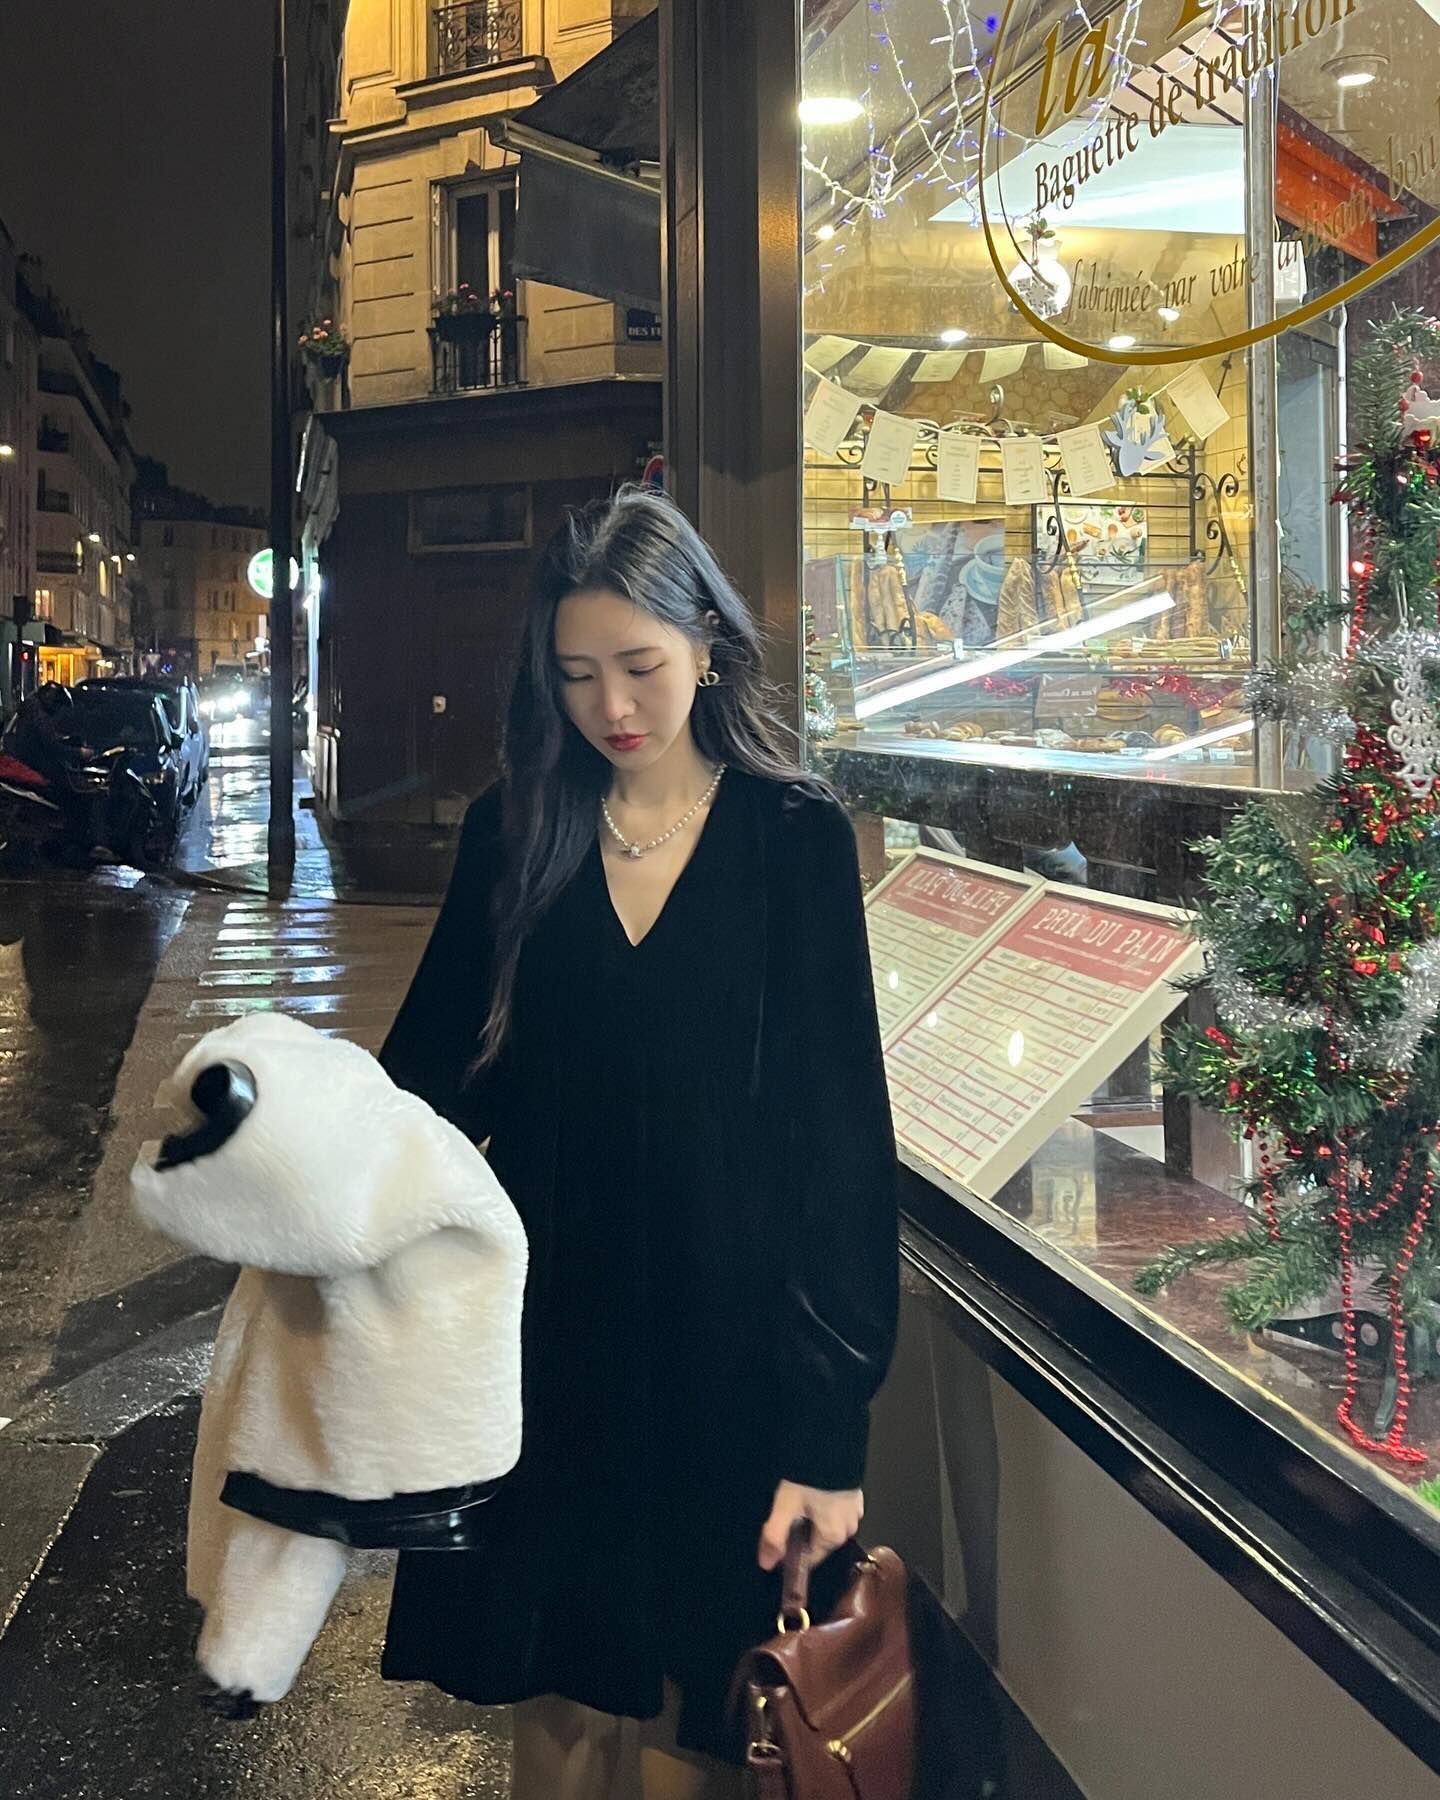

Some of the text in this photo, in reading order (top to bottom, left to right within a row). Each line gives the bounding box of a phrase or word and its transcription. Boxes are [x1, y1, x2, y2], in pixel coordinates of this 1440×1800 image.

[1035, 17, 1114, 136] la
[1035, 0, 1356, 212] Baguette de tradition
[1064, 258, 1151, 332] fabriquée
[1163, 273, 1197, 331] par
[1210, 243, 1259, 297] votre
[1031, 907, 1186, 964] PRIX DU PAIN
